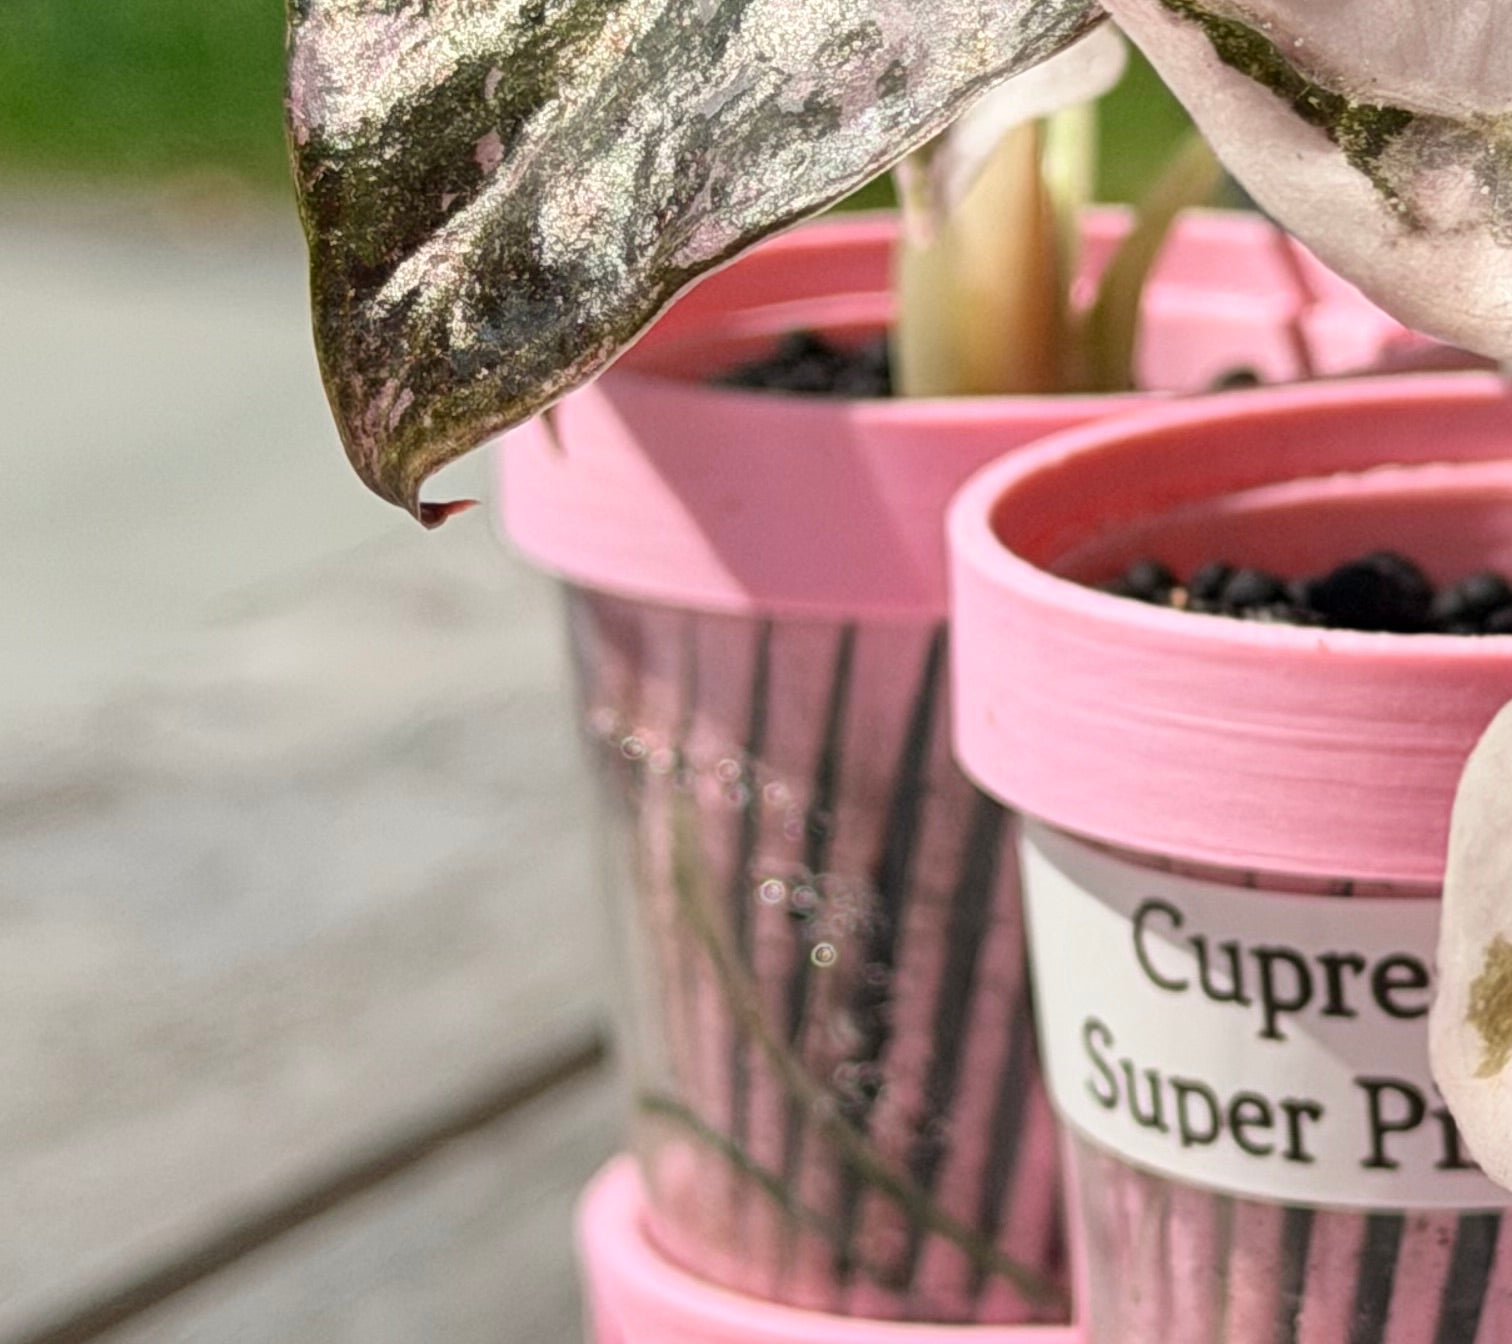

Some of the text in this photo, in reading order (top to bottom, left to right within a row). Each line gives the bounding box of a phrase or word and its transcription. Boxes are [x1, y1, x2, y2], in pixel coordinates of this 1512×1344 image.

[1131, 898, 1434, 1041] Cupre
[1082, 1016, 1483, 1170] Super Pi
